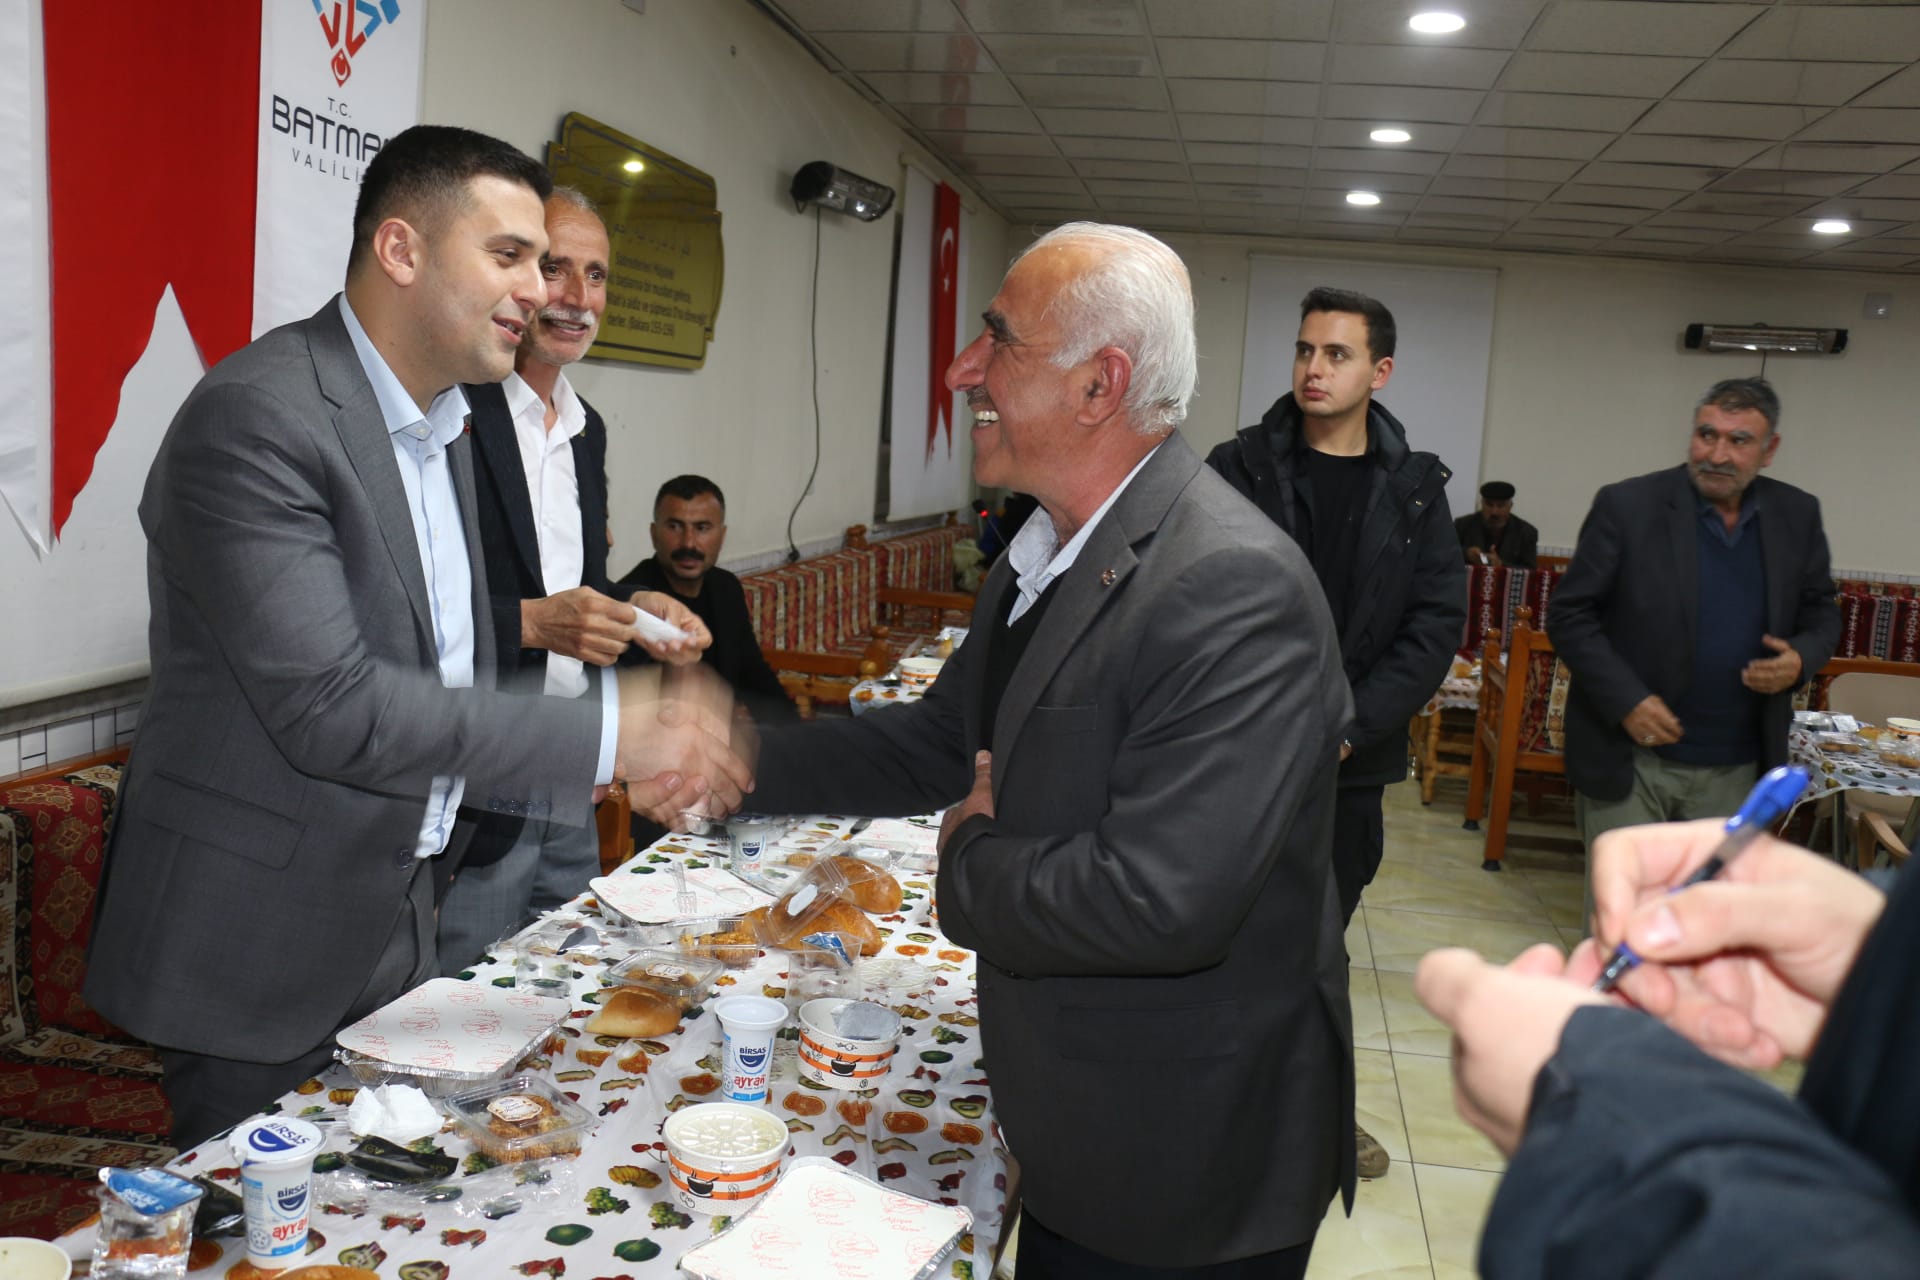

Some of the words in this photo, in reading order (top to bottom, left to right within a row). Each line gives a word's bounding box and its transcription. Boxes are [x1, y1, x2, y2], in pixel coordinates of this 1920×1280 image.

[327, 97, 351, 118] T.C.
[272, 94, 391, 162] BATMA
[292, 148, 365, 182] VALİLİ
